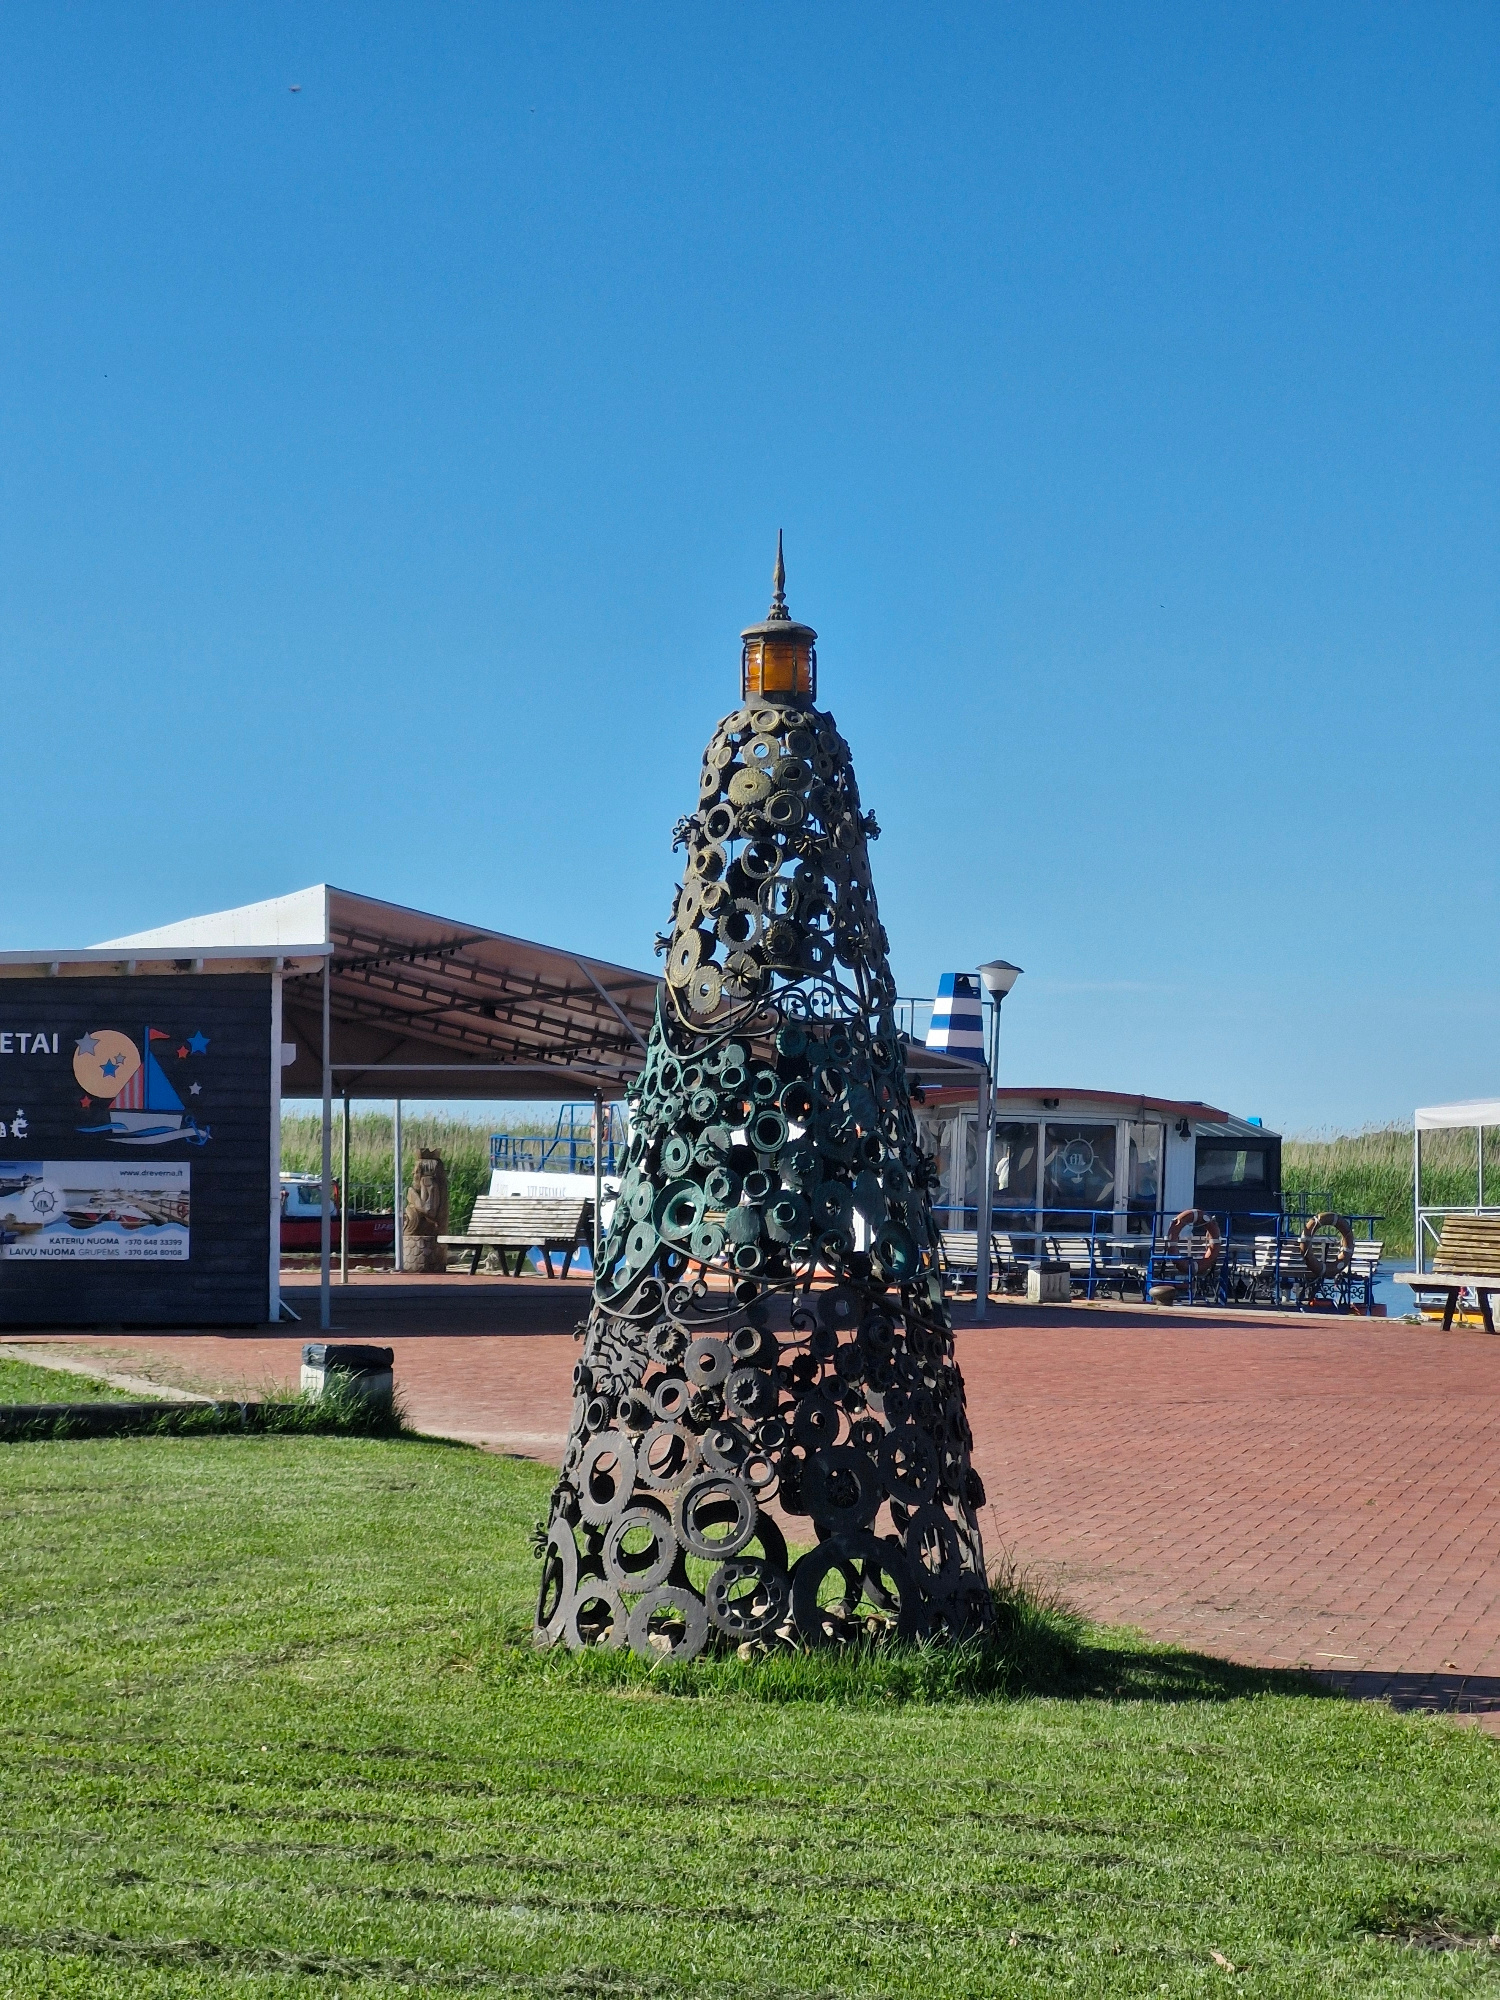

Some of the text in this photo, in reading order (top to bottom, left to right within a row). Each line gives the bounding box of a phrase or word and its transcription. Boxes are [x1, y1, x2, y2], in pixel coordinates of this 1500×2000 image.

[0, 1032, 59, 1054] ETAI
[49, 1237, 85, 1246] KATERIŲ
[86, 1237, 120, 1245] NUOMA
[9, 1248, 38, 1257] LAIVŲ
[39, 1248, 76, 1256] NUOMA
[78, 1248, 120, 1256] GRUPEMS
